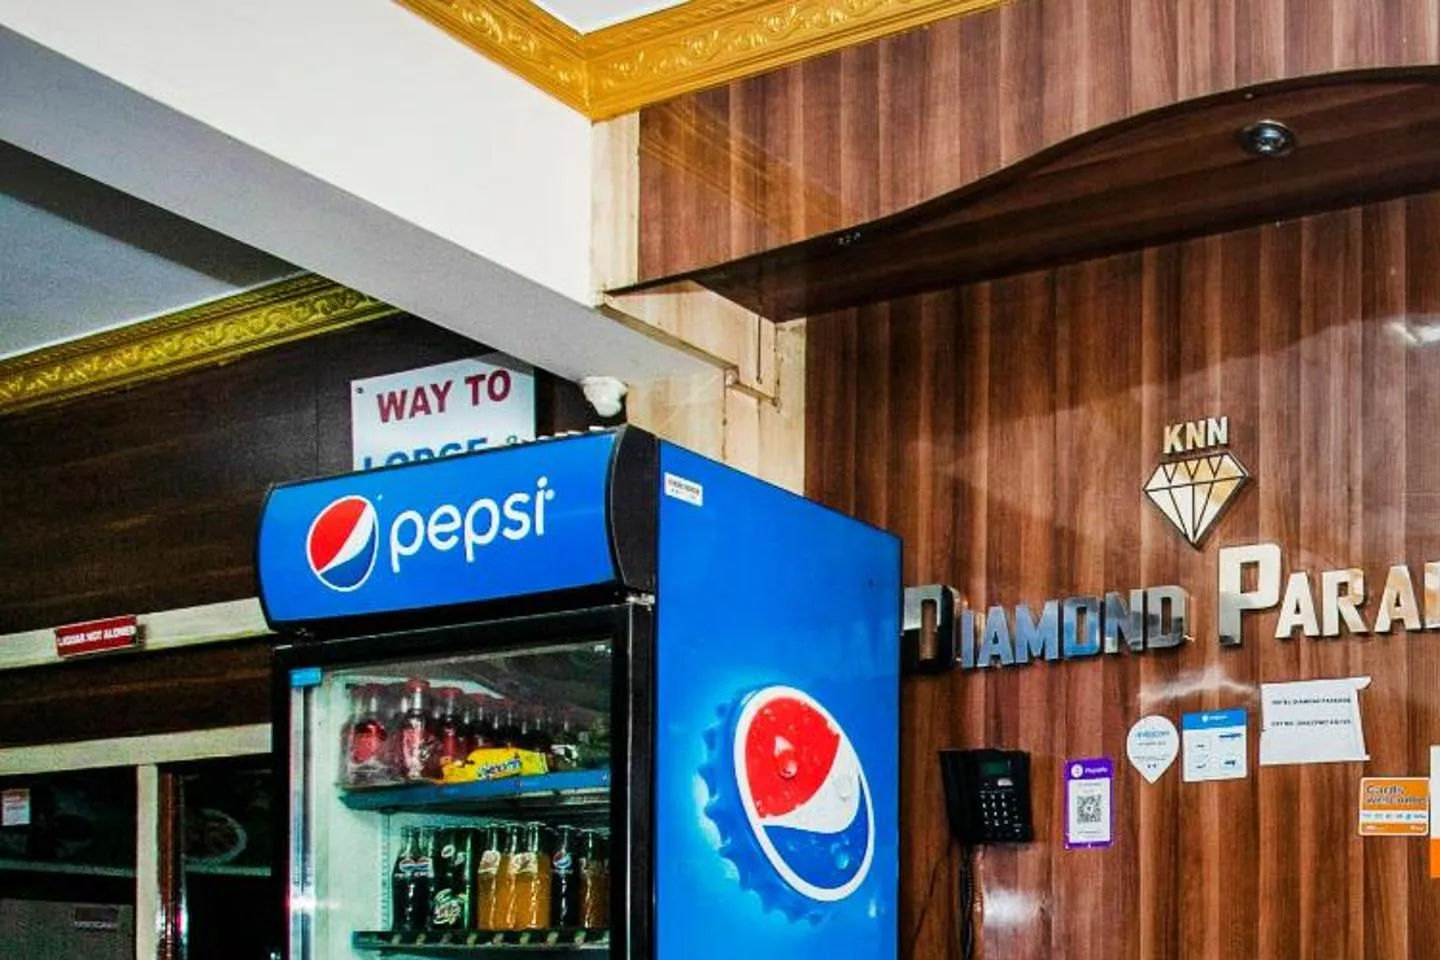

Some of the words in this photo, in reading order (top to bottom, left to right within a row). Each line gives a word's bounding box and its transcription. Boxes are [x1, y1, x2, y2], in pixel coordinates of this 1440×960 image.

[376, 379, 454, 424] WAY
[464, 368, 512, 407] TO
[1163, 416, 1229, 454] KNN
[390, 476, 549, 573] pepsi
[902, 583, 1190, 673] DIAMOND
